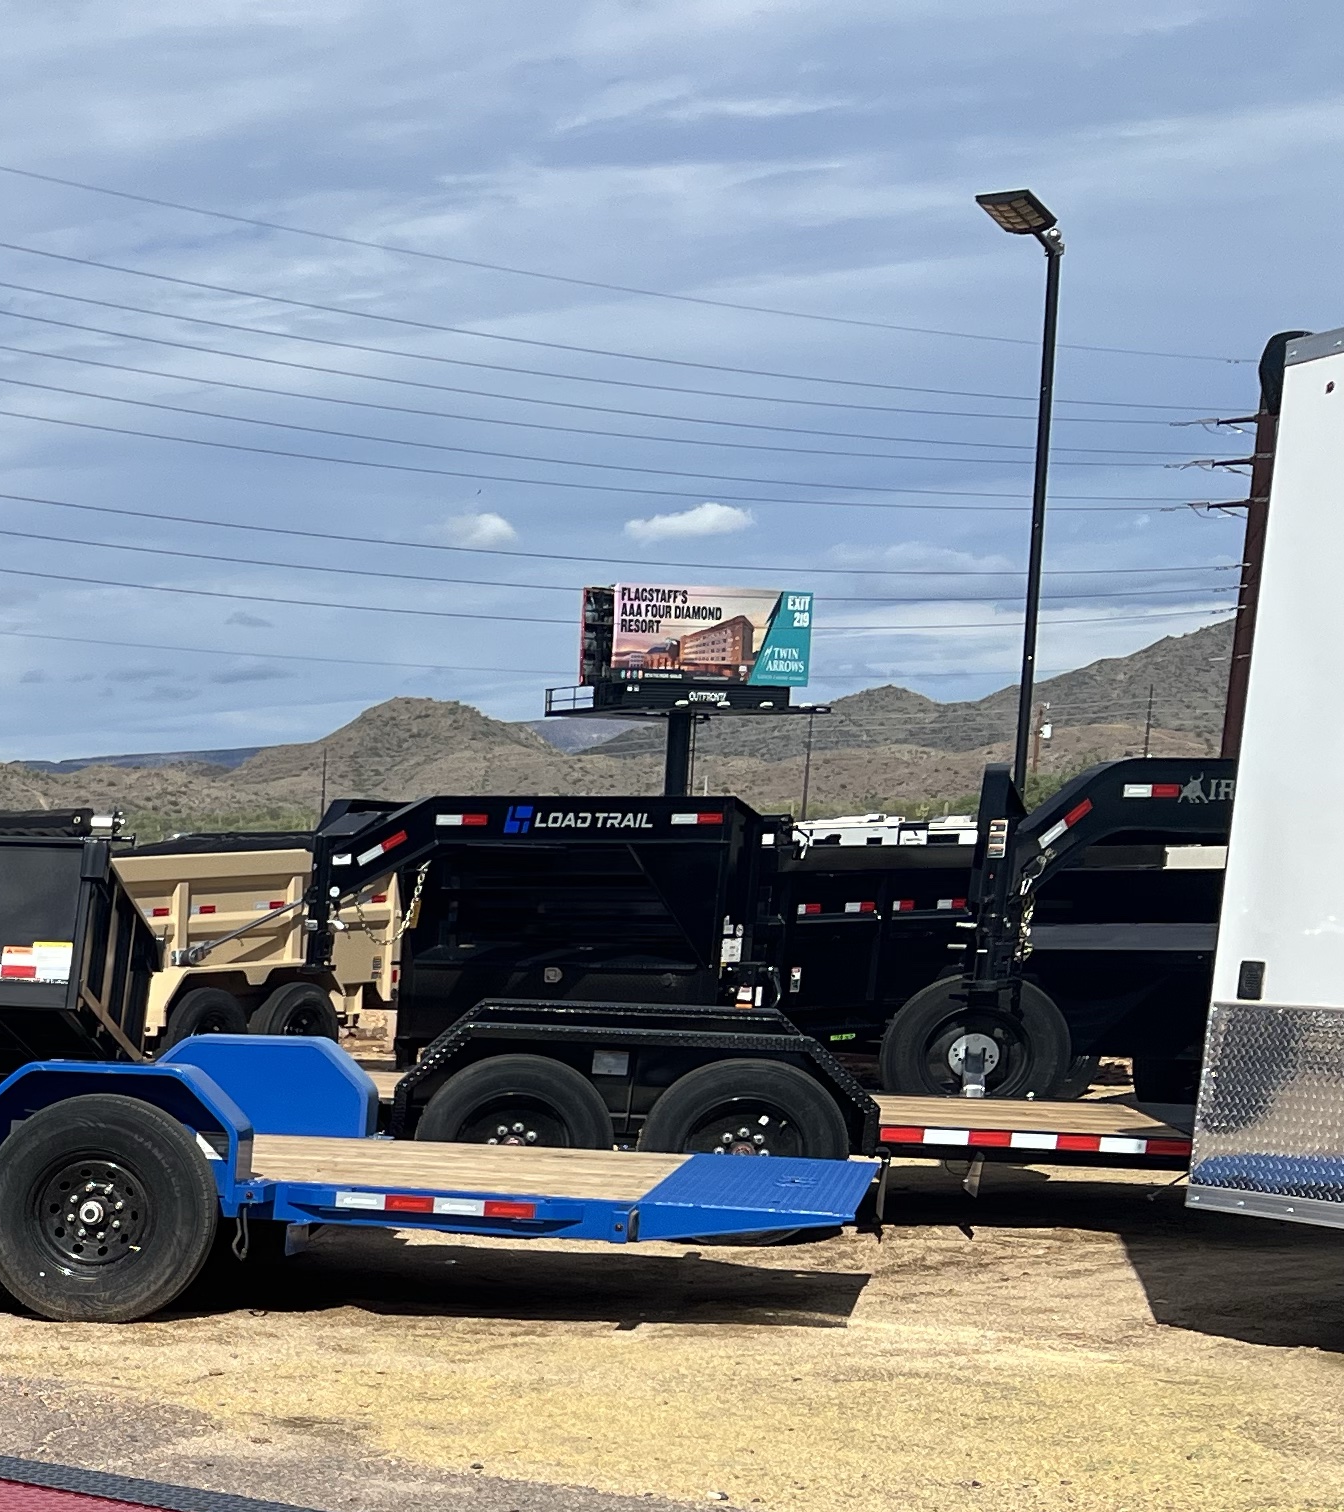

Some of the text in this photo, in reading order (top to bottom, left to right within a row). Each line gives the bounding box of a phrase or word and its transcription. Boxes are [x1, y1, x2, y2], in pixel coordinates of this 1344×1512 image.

[621, 587, 688, 604] FLAGSTAFF'S
[787, 595, 811, 611] EXIT
[621, 603, 722, 620] AAA FOUR DIAMOND
[620, 618, 661, 633] RESORT
[793, 612, 810, 627] 219
[773, 647, 799, 660] TWIN
[766, 660, 805, 673] ARROWS
[534, 812, 653, 828] LOAD TRAIL
